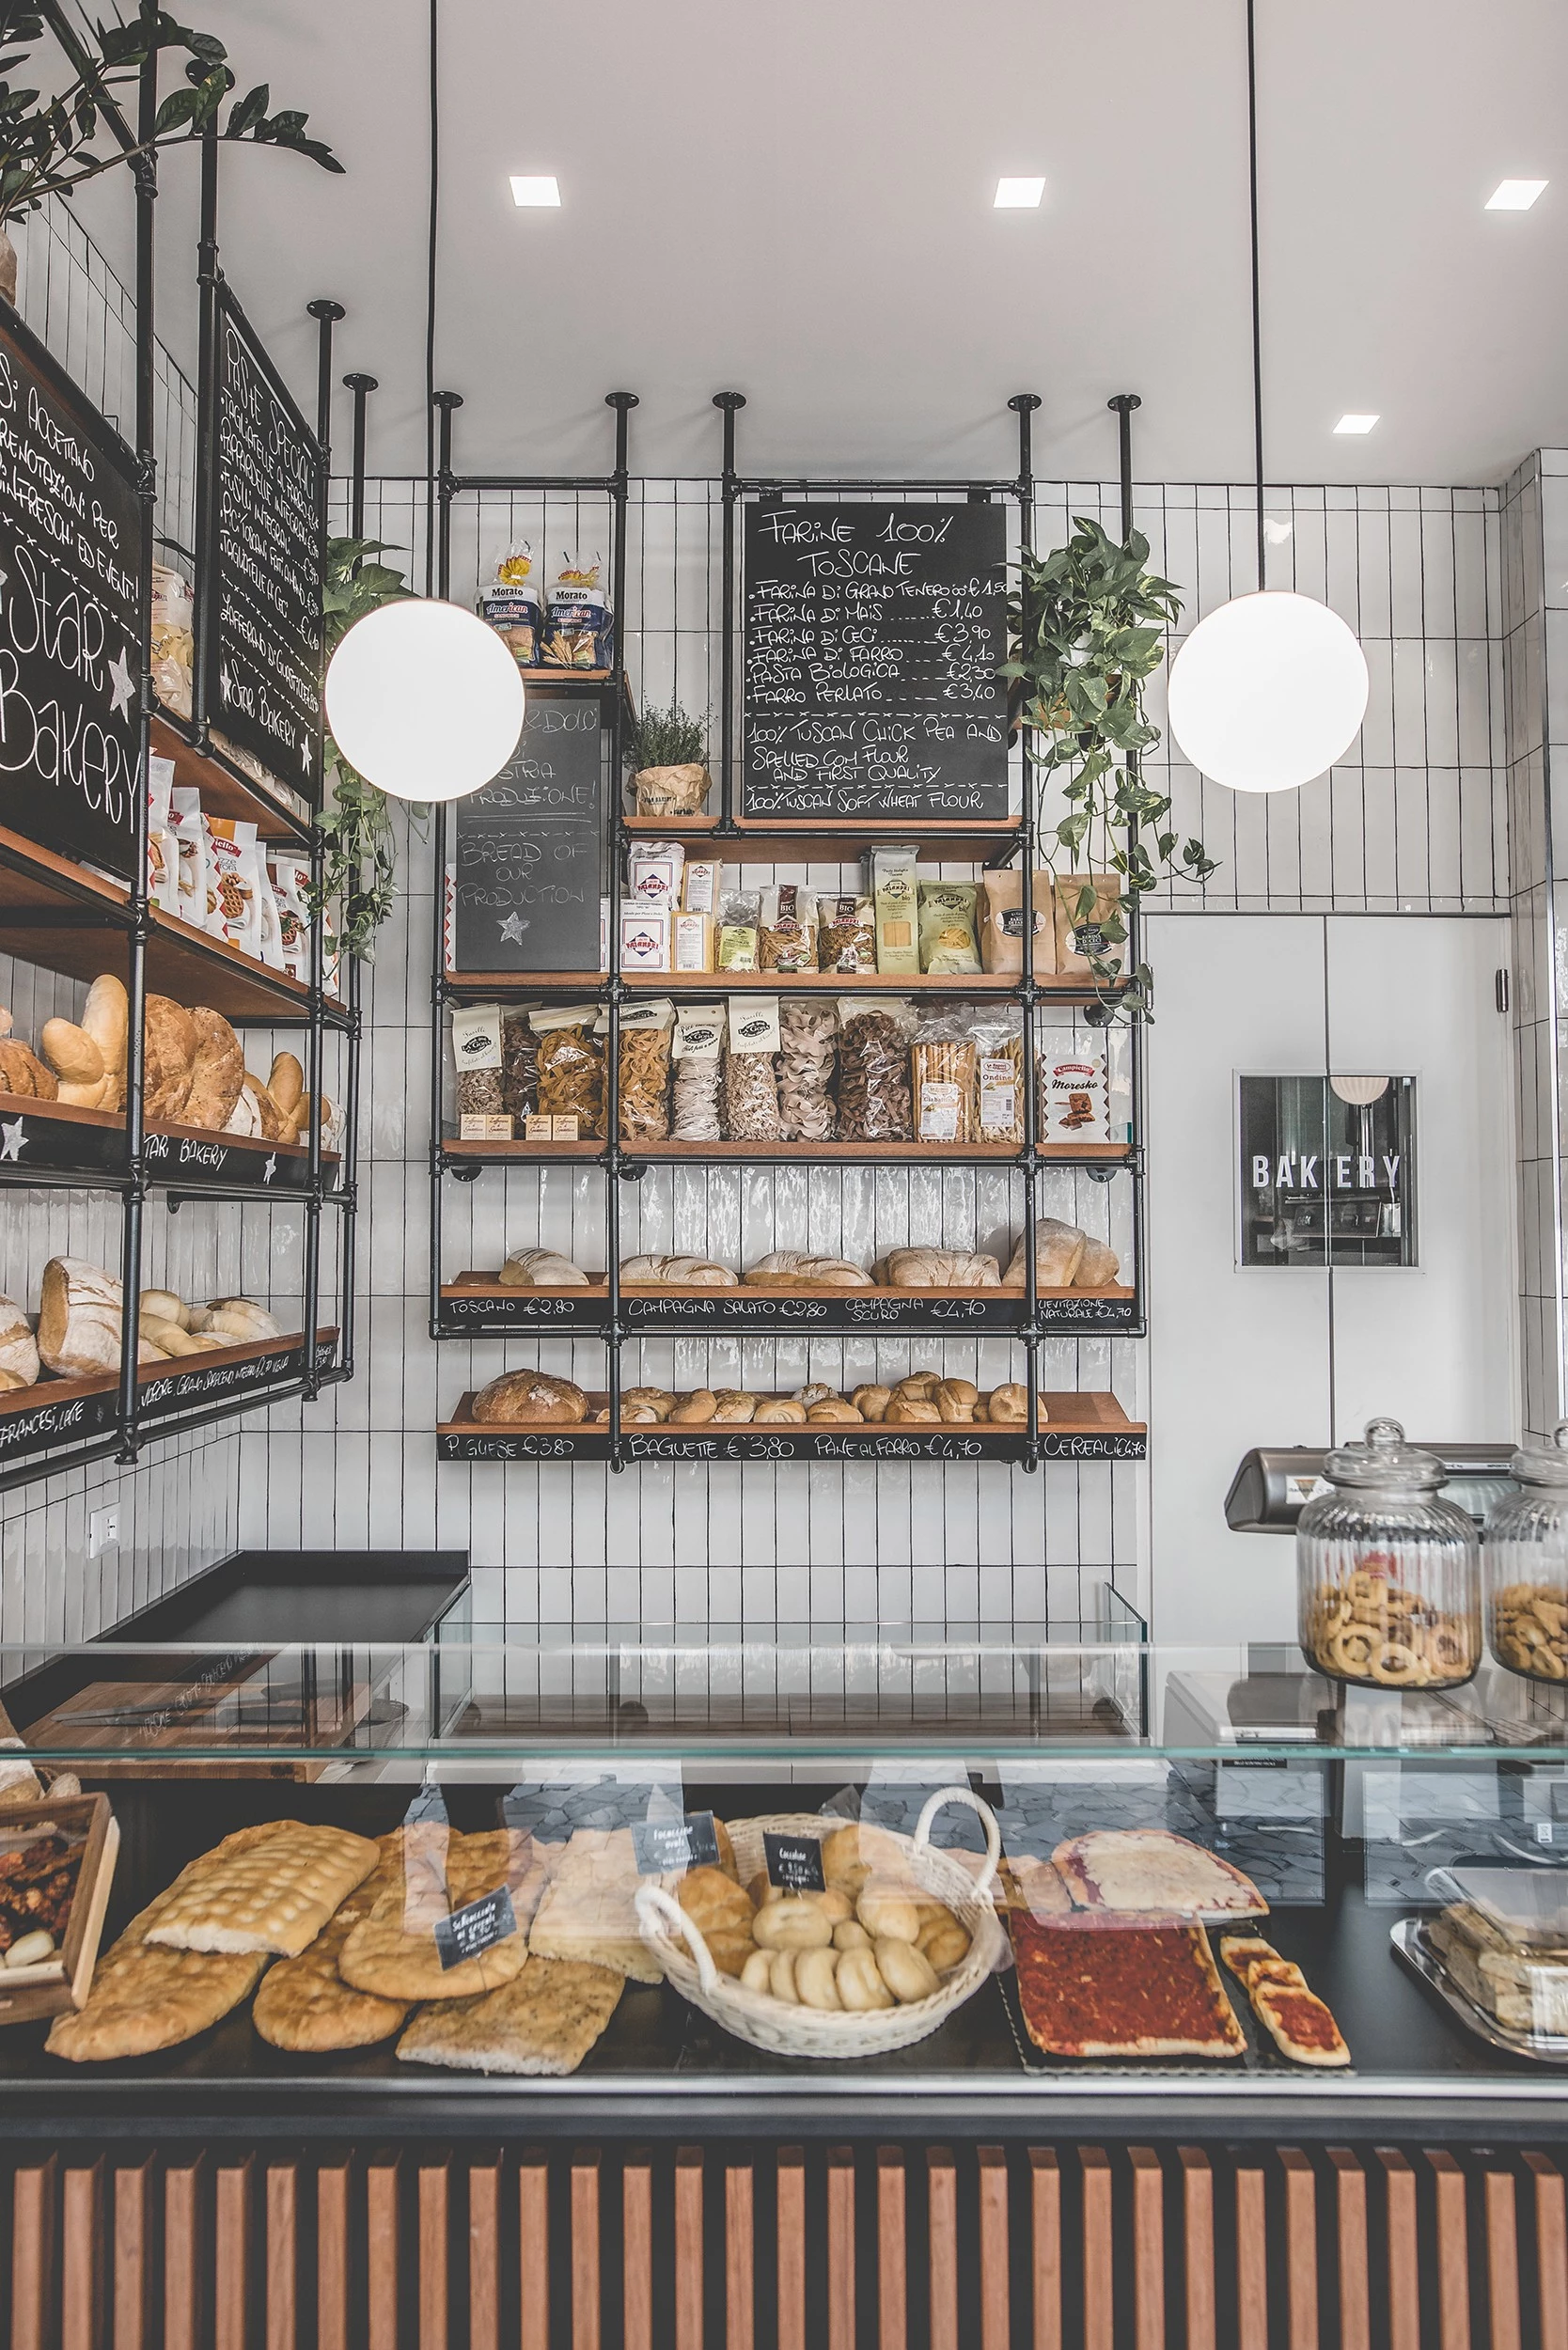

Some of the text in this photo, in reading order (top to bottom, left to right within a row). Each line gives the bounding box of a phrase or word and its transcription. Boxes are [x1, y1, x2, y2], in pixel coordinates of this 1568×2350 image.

[28, 386, 95, 482] ACCETTANO
[0, 462, 74, 546] INFRESCHI
[77, 532, 95, 569] ED
[91, 500, 119, 551] PER
[876, 512, 954, 543] 100%
[492, 588, 524, 596] Morato
[556, 591, 588, 601] Morato
[845, 581, 895, 600] GRANO
[896, 580, 950, 597] TENERO
[486, 603, 528, 614] American
[551, 606, 591, 618] American
[850, 646, 904, 662] FARRO
[750, 661, 802, 684] PASTA
[753, 684, 807, 703] FARRO
[815, 682, 883, 701] PERLATO
[746, 725, 788, 744] 100%
[788, 719, 854, 744] TUSCAN
[923, 716, 955, 739] PEA
[966, 723, 1003, 743] AND
[773, 767, 808, 782] AND
[815, 766, 864, 781] FIRST
[746, 791, 782, 811] 100%
[837, 790, 880, 812] SOFT
[878, 790, 923, 808] WHEAT
[927, 791, 984, 809] FLOUR
[461, 841, 588, 867] BREAD OF
[495, 863, 534, 881] OUR
[458, 883, 585, 907] PRODUCTION
[1051, 1079, 1098, 1089] Moresko
[143, 1133, 228, 1172] TAR BAKERY
[449, 1299, 516, 1314] TOSCANO
[628, 1298, 715, 1316] CAMPAGNA
[844, 1297, 924, 1311] CAMPAGNA
[851, 1309, 900, 1322] SCURO
[1040, 1308, 1094, 1321] NATURALE
[629, 1434, 718, 1459] BAGUETTE
[814, 1434, 858, 1457] PANE
[876, 1437, 921, 1457] FARRO
